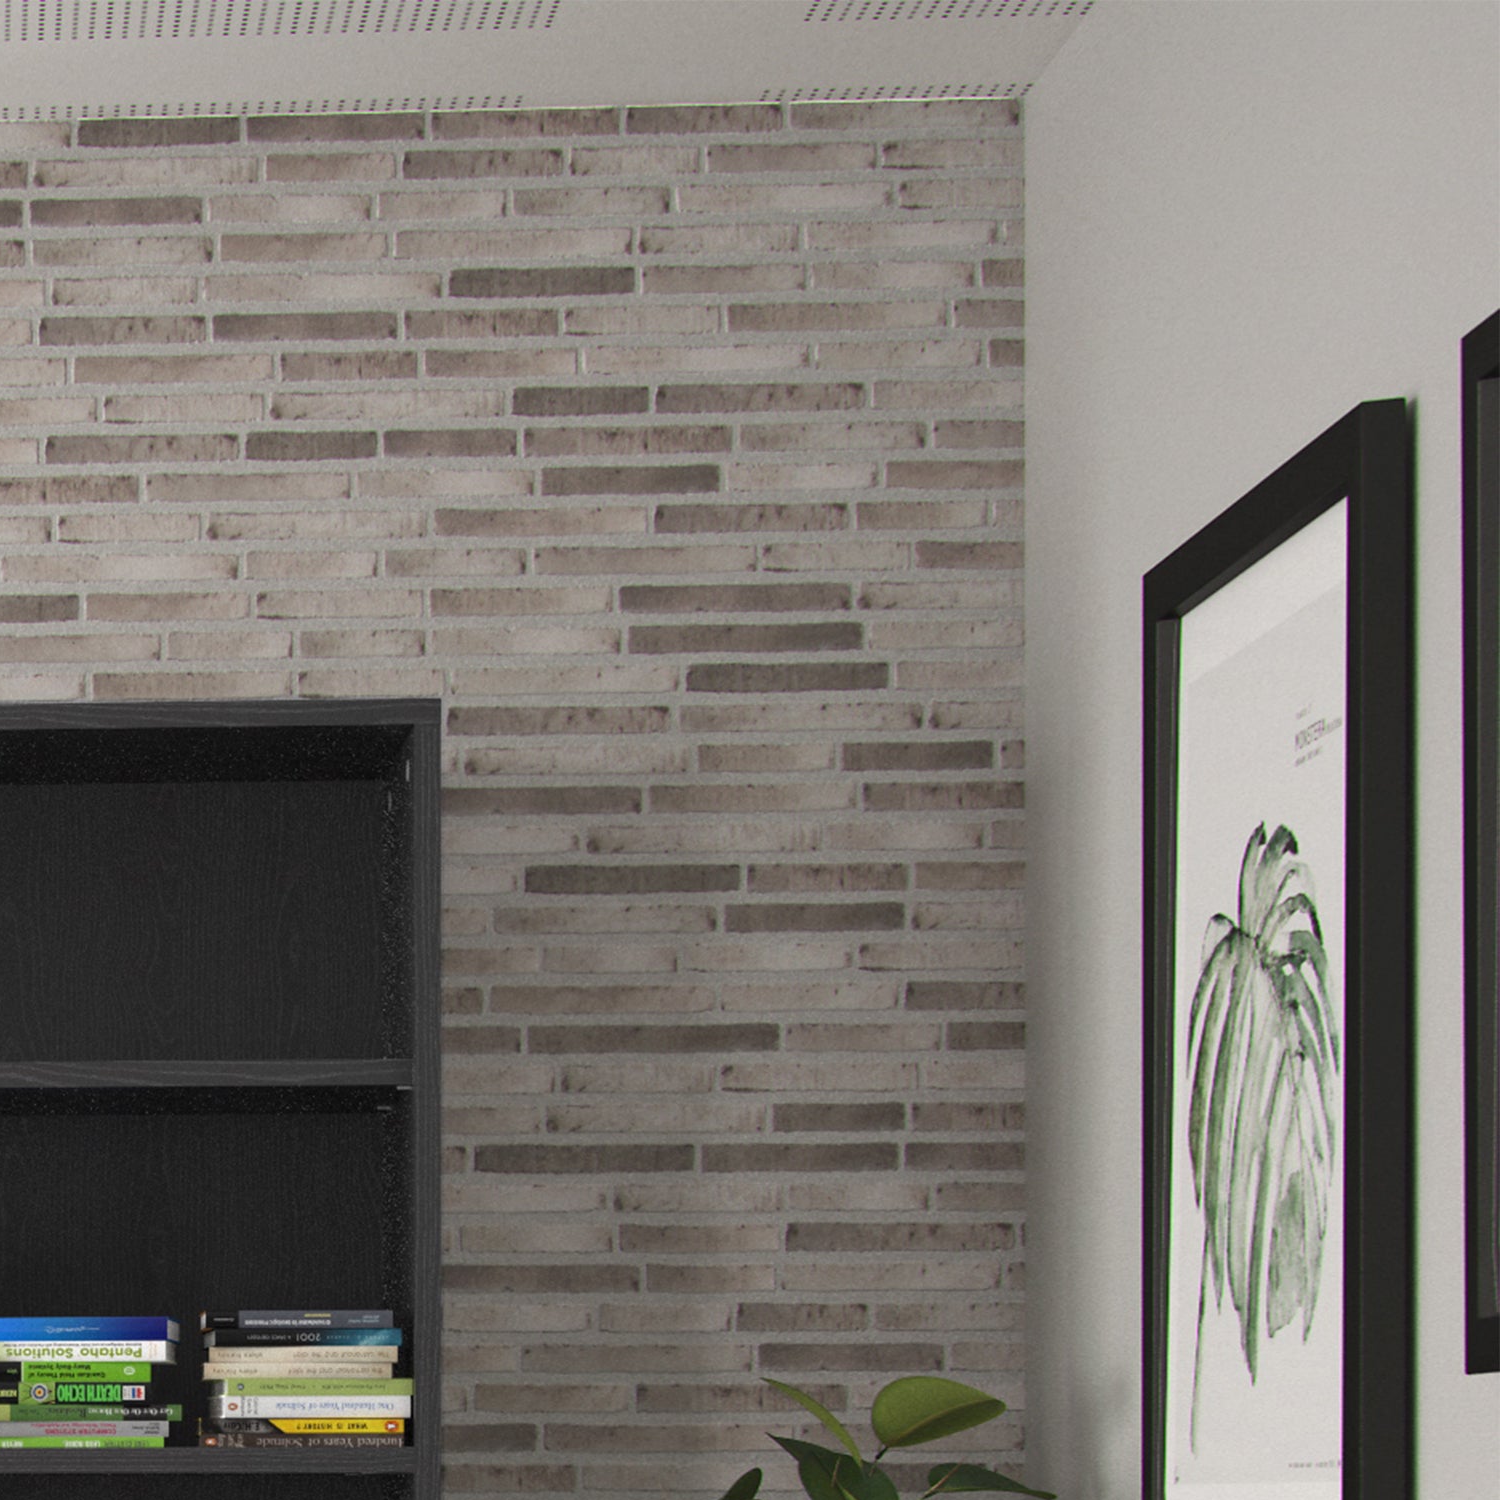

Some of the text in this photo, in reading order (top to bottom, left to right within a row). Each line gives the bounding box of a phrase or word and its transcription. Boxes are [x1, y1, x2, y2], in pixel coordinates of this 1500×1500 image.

[295, 1332, 321, 1342] 2001
[6, 1347, 143, 1358] Pentaho Solutions
[57, 1384, 121, 1402] DEATH ECHO
[256, 1437, 303, 1447] Solitude
[307, 1437, 320, 1447] of
[322, 1437, 354, 1447] Years
